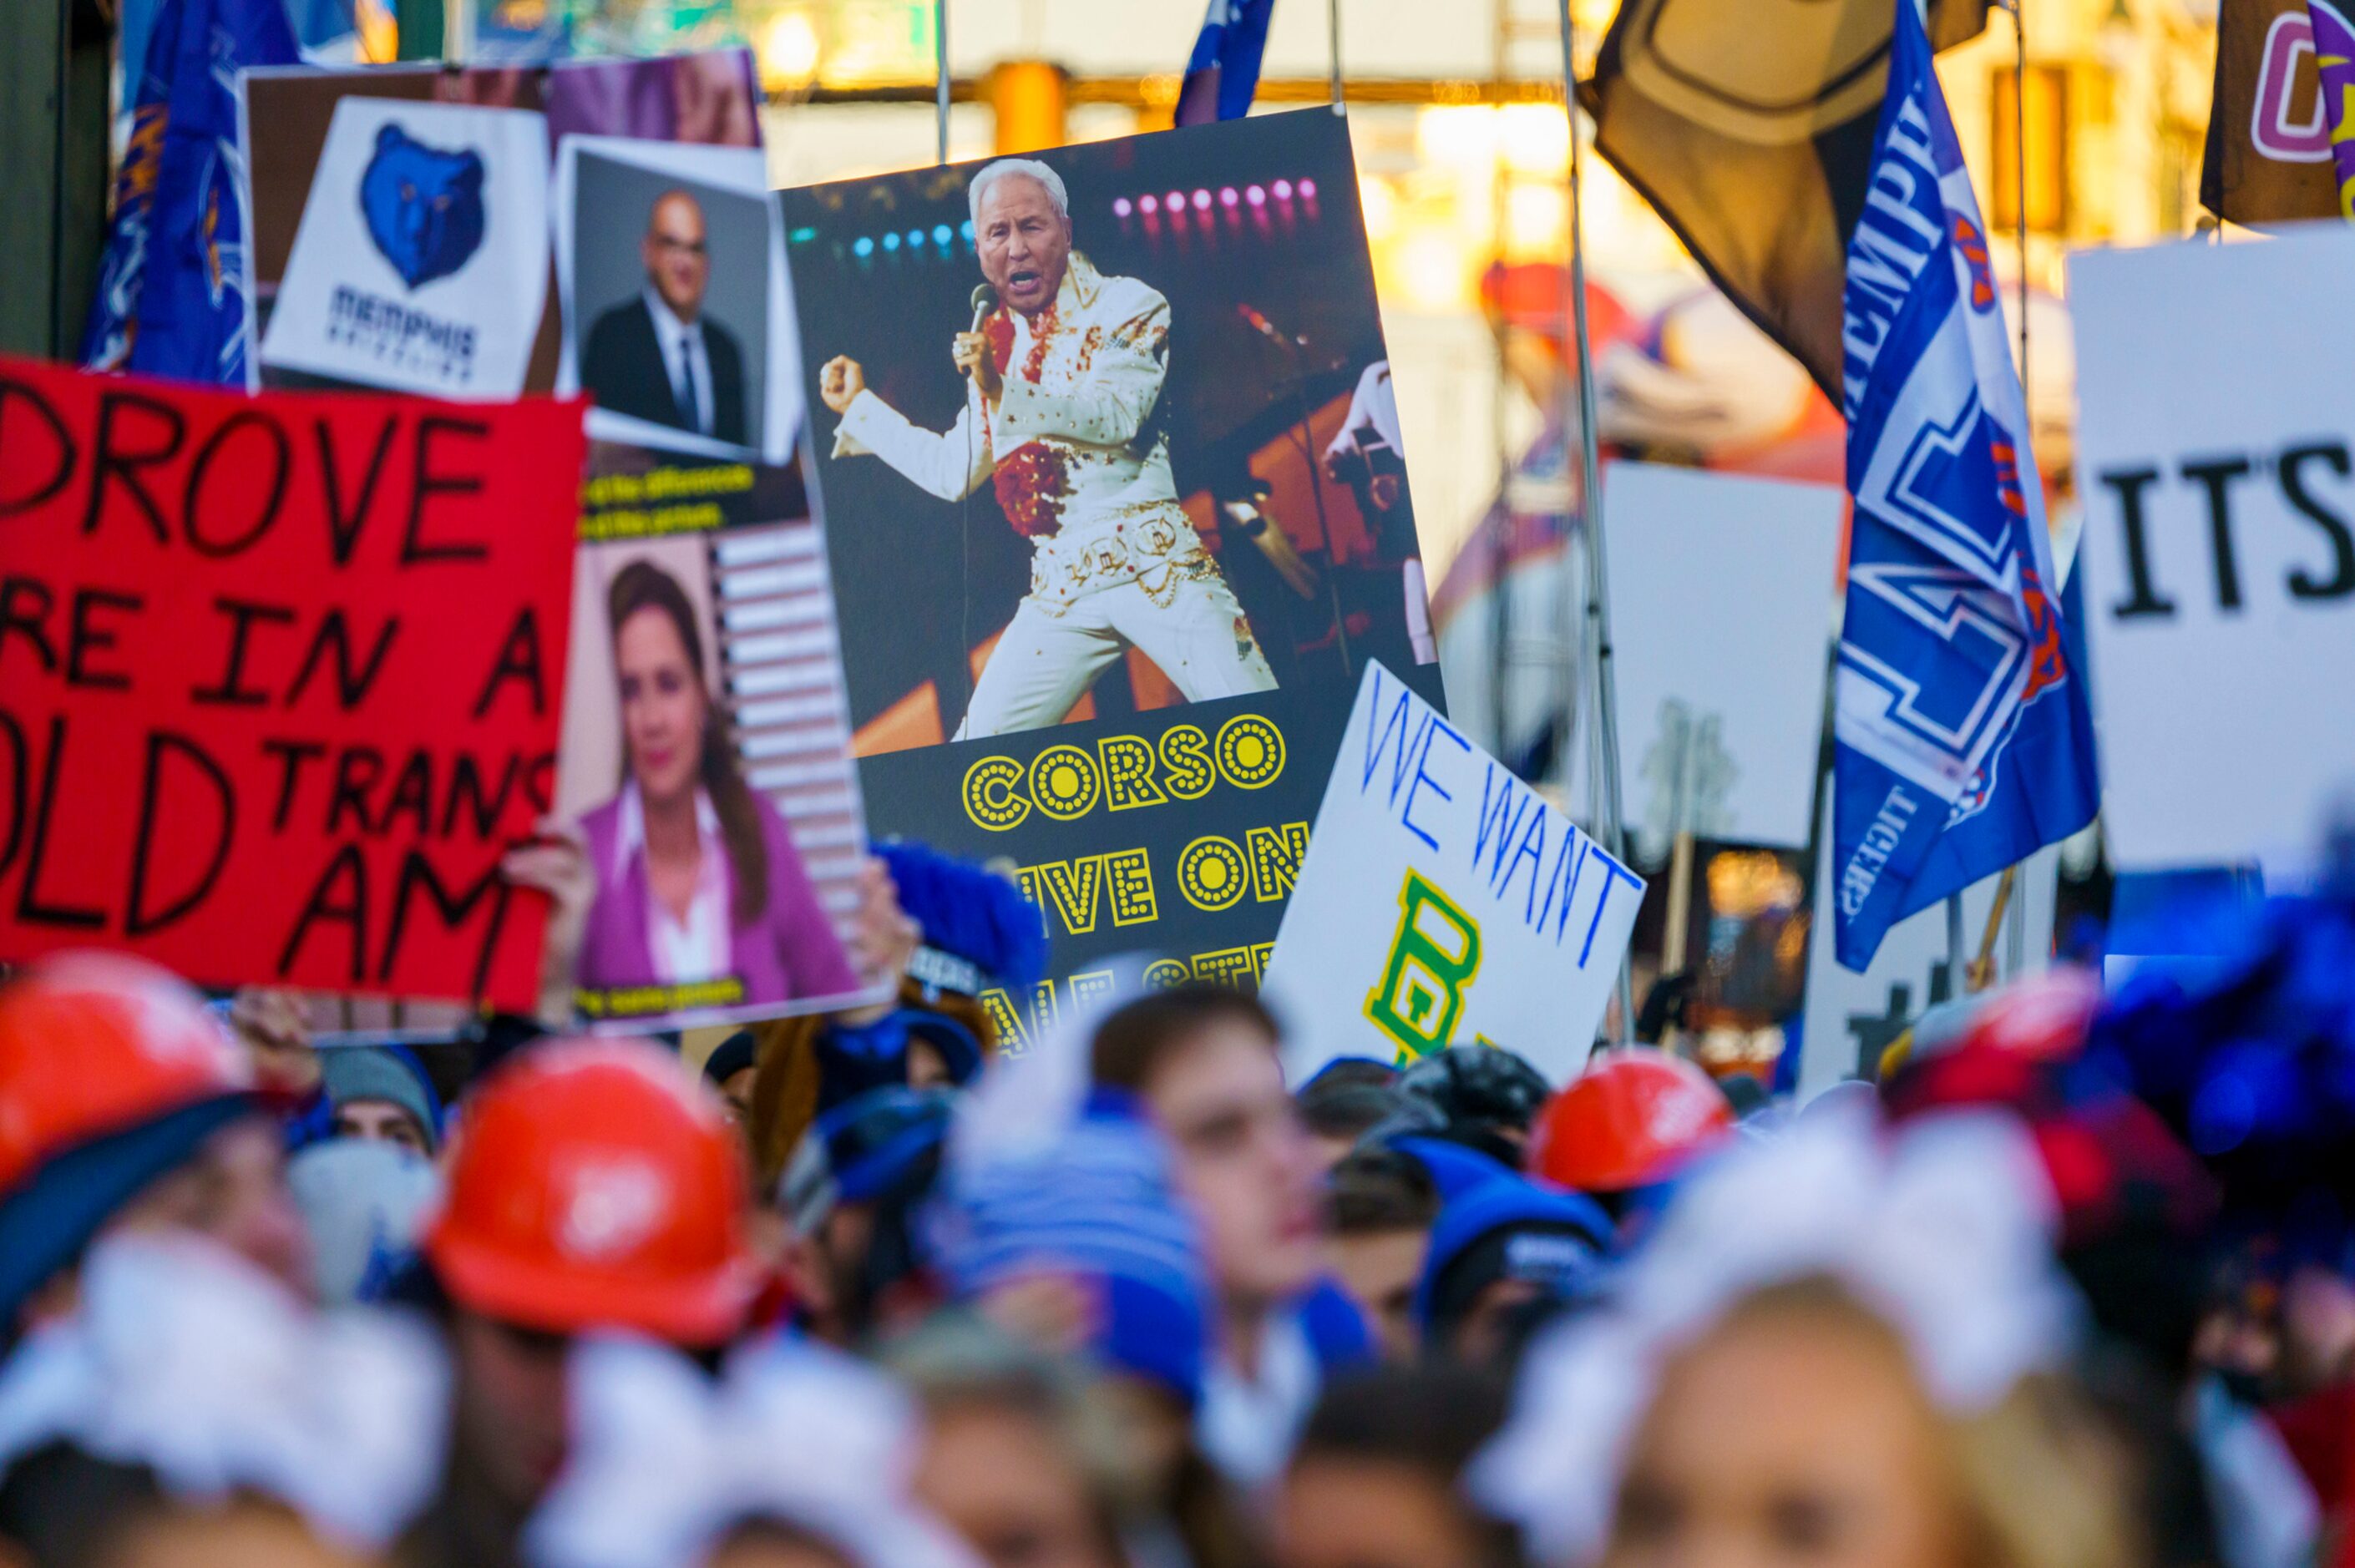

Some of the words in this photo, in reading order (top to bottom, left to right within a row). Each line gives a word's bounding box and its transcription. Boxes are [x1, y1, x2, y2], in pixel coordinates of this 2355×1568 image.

[192, 597, 403, 714] IN
[472, 599, 548, 722] A
[963, 714, 1286, 832] CORSO
[1361, 670, 1472, 853] WE
[1472, 761, 1643, 970] WANT
[276, 843, 514, 1004] AM
[1178, 822, 1309, 912] ON
